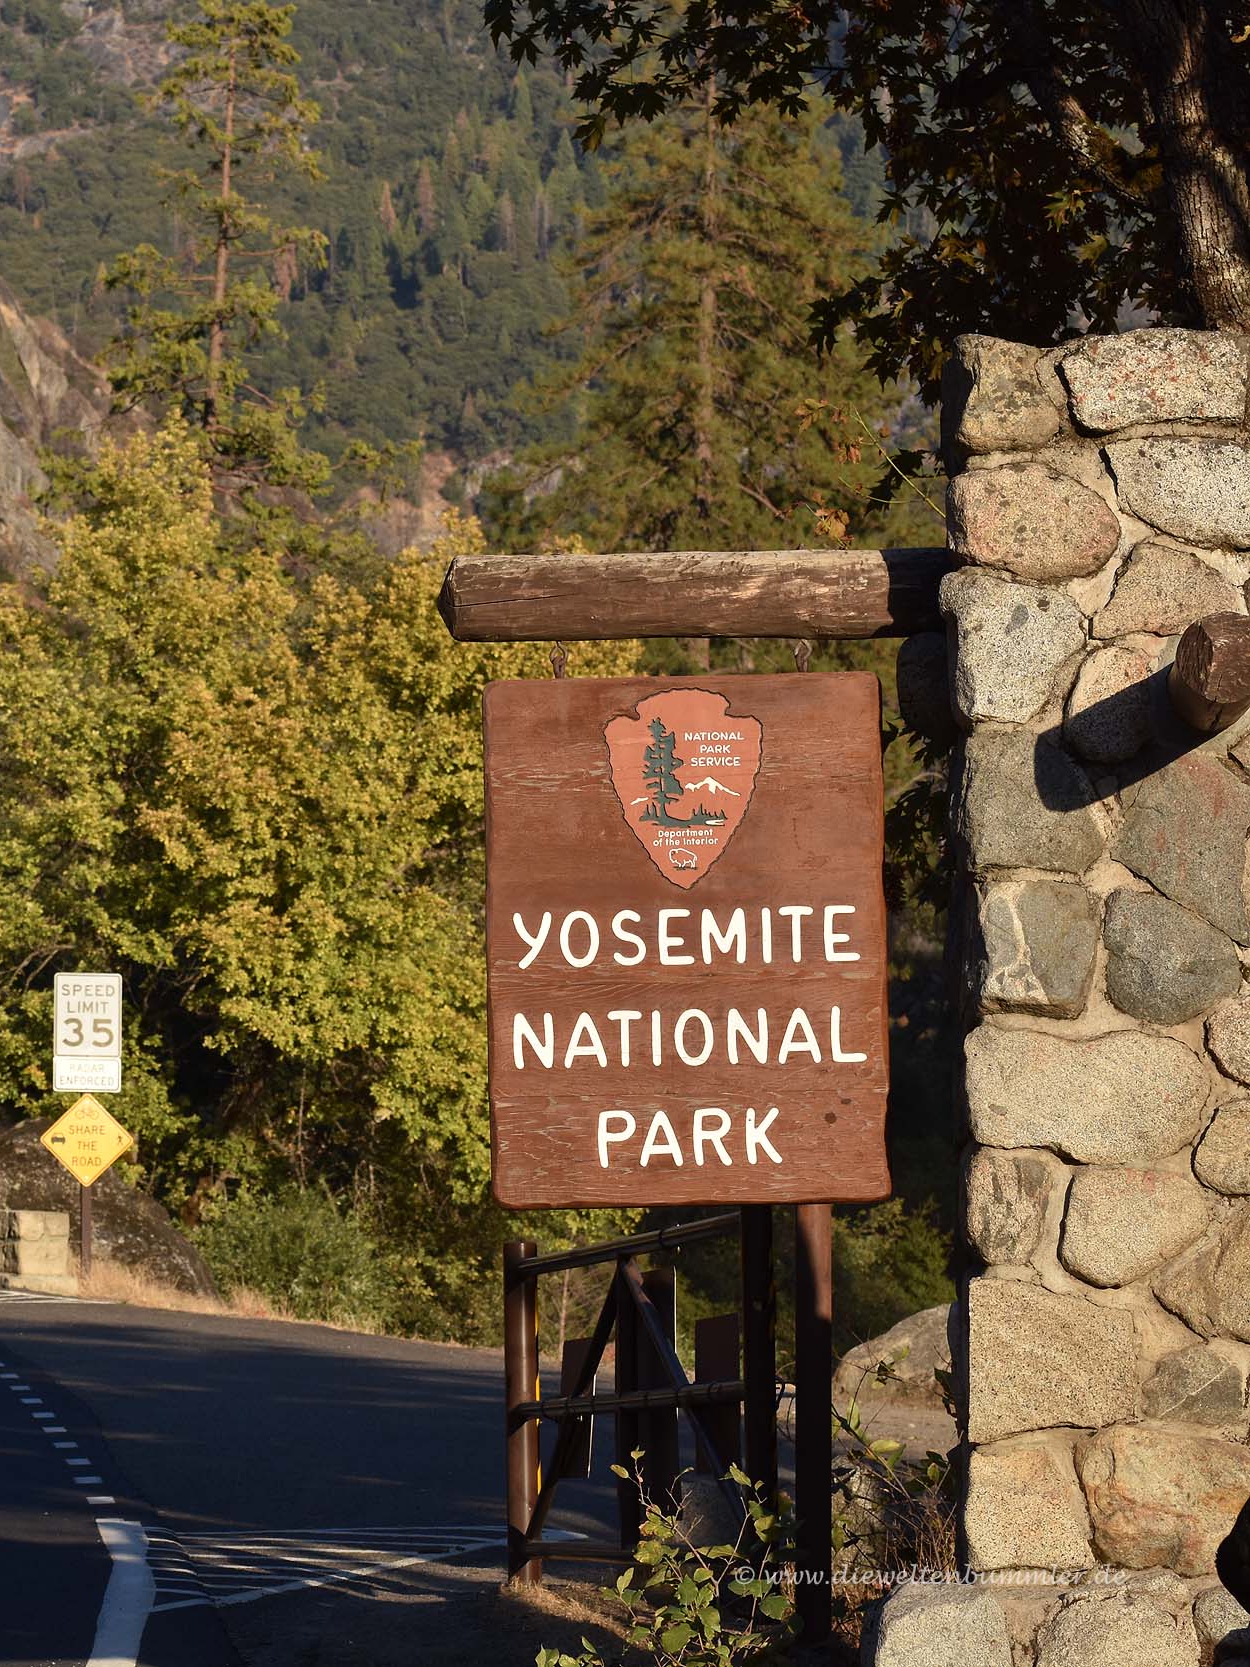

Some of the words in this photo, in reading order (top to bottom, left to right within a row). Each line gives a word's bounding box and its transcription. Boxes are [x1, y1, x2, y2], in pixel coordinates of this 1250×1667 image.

[684, 731, 744, 741] NATIONAL
[699, 744, 731, 753] PARK
[690, 756, 741, 767] SERVICE
[658, 828, 713, 839] Department
[653, 838, 663, 847] of
[665, 837, 680, 846] the
[683, 837, 719, 846] Interior
[512, 904, 861, 970] YOSEMITE
[61, 984, 115, 997] SPEED
[66, 1001, 109, 1014] LIMIT
[62, 1018, 115, 1048] 35
[512, 1005, 868, 1070] NATIONAL
[59, 1075, 115, 1086] ENFORCED
[68, 1124, 106, 1135] SHARE
[597, 1106, 783, 1169] PARK
[77, 1140, 98, 1151] THE
[71, 1156, 102, 1167] ROAD
